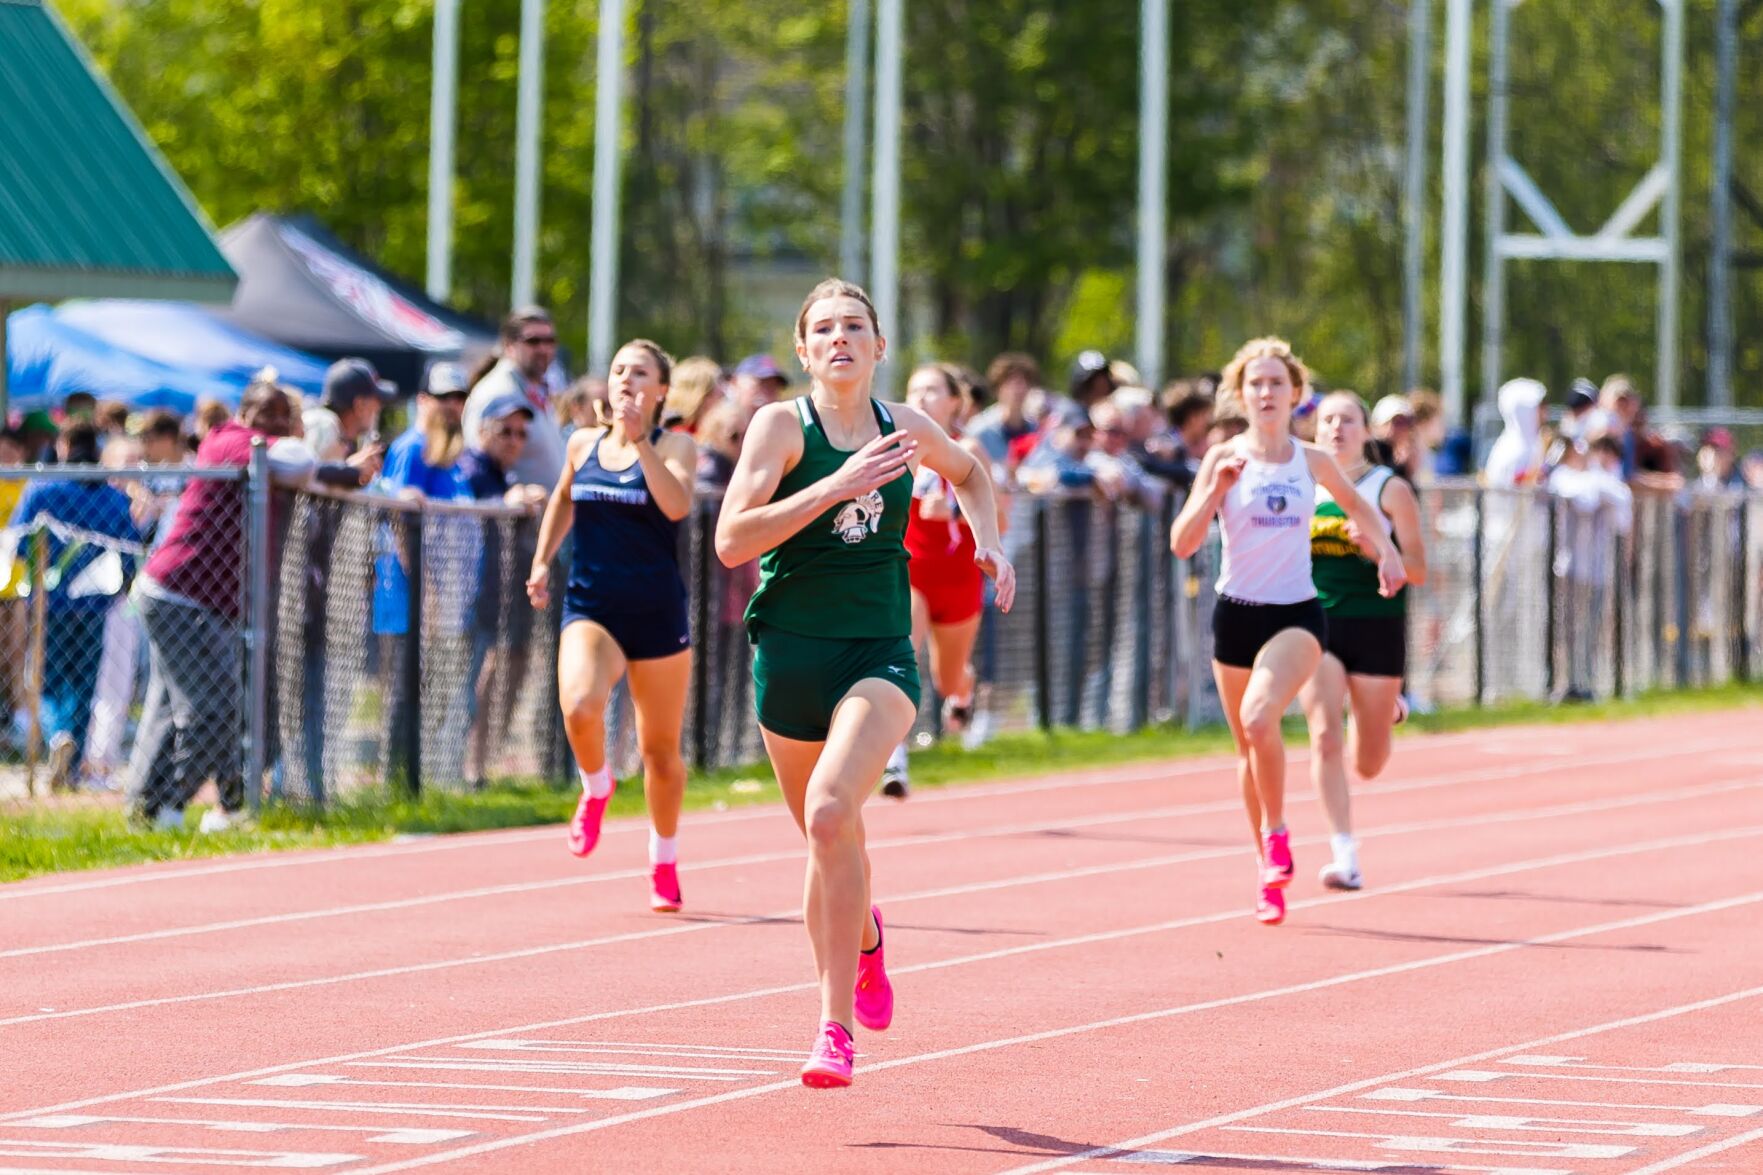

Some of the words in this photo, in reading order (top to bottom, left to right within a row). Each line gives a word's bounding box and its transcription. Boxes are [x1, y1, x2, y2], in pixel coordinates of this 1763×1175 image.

[870, 492, 882, 518] REL
[0, 1038, 867, 1175] UNIVER
[1055, 1054, 1763, 1175] SLIPPE
